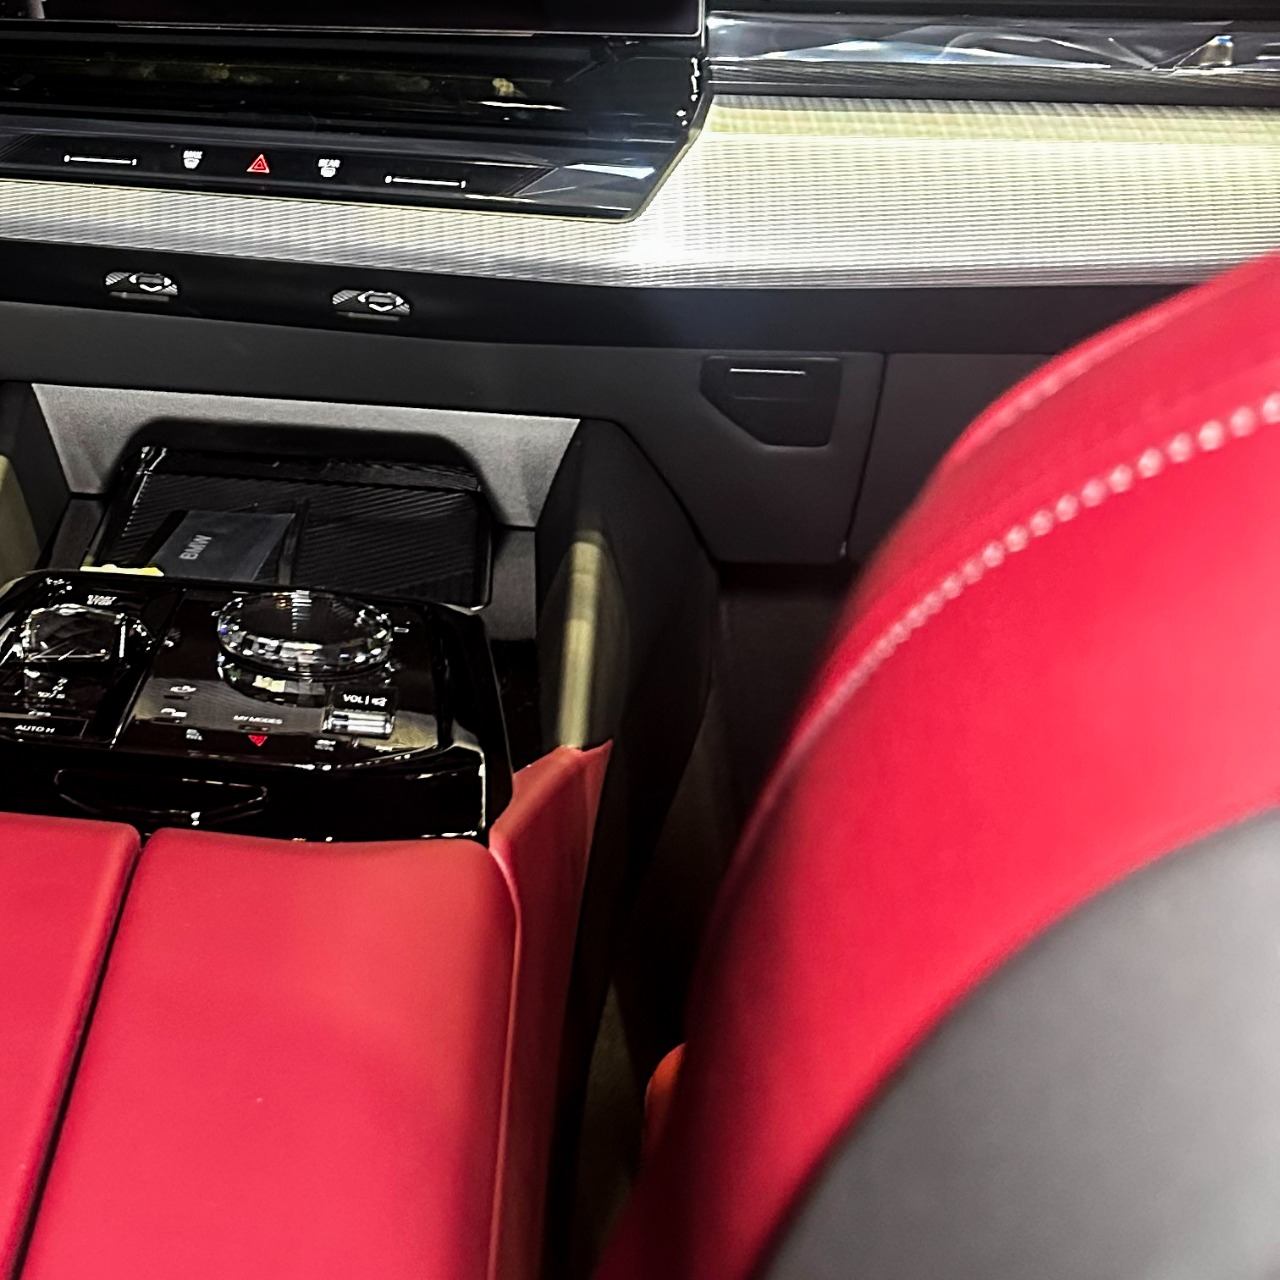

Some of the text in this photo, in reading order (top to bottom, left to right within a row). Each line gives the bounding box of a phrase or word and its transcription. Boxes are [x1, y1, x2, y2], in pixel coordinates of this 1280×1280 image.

[179, 534, 212, 560] BMW
[342, 693, 364, 704] VOL
[14, 724, 45, 732] AUTO
